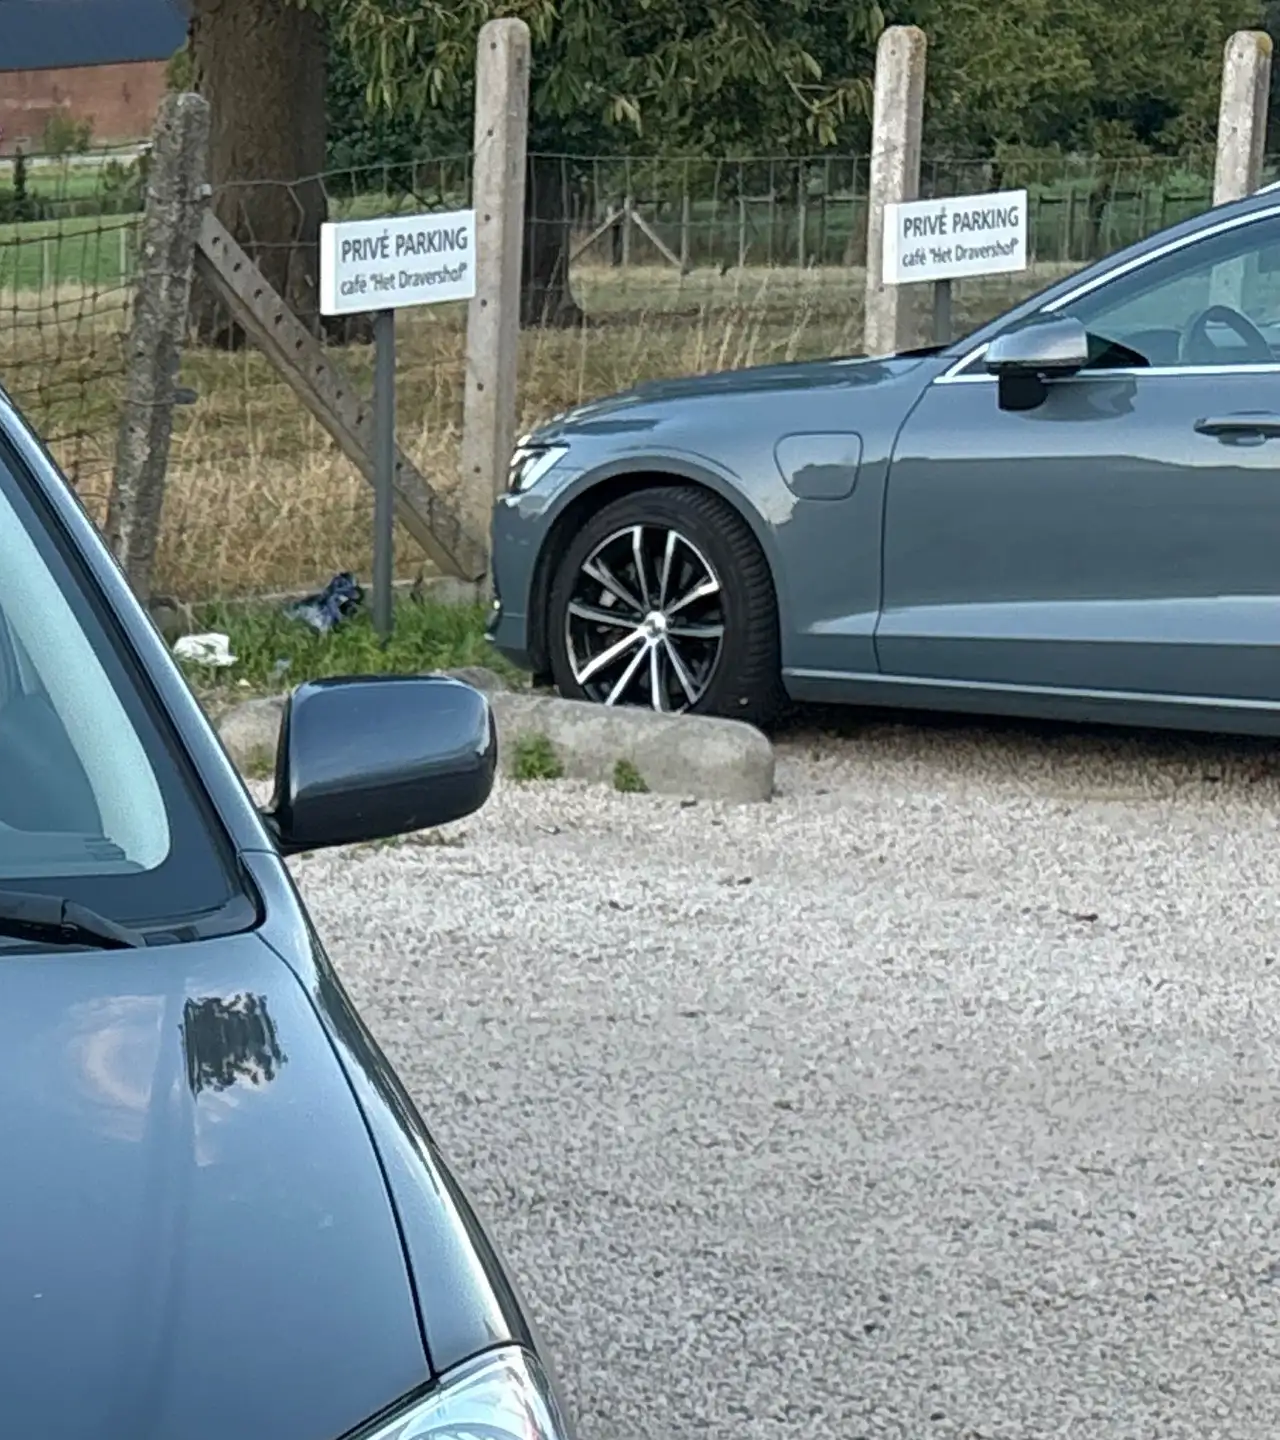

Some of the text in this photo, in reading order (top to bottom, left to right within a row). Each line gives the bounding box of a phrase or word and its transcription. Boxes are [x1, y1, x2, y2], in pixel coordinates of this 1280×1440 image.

[903, 206, 1019, 238] PRIVÉ PARKING
[341, 227, 468, 263] PRIVÉ PARKING
[902, 246, 927, 267] café
[341, 273, 368, 295] café
